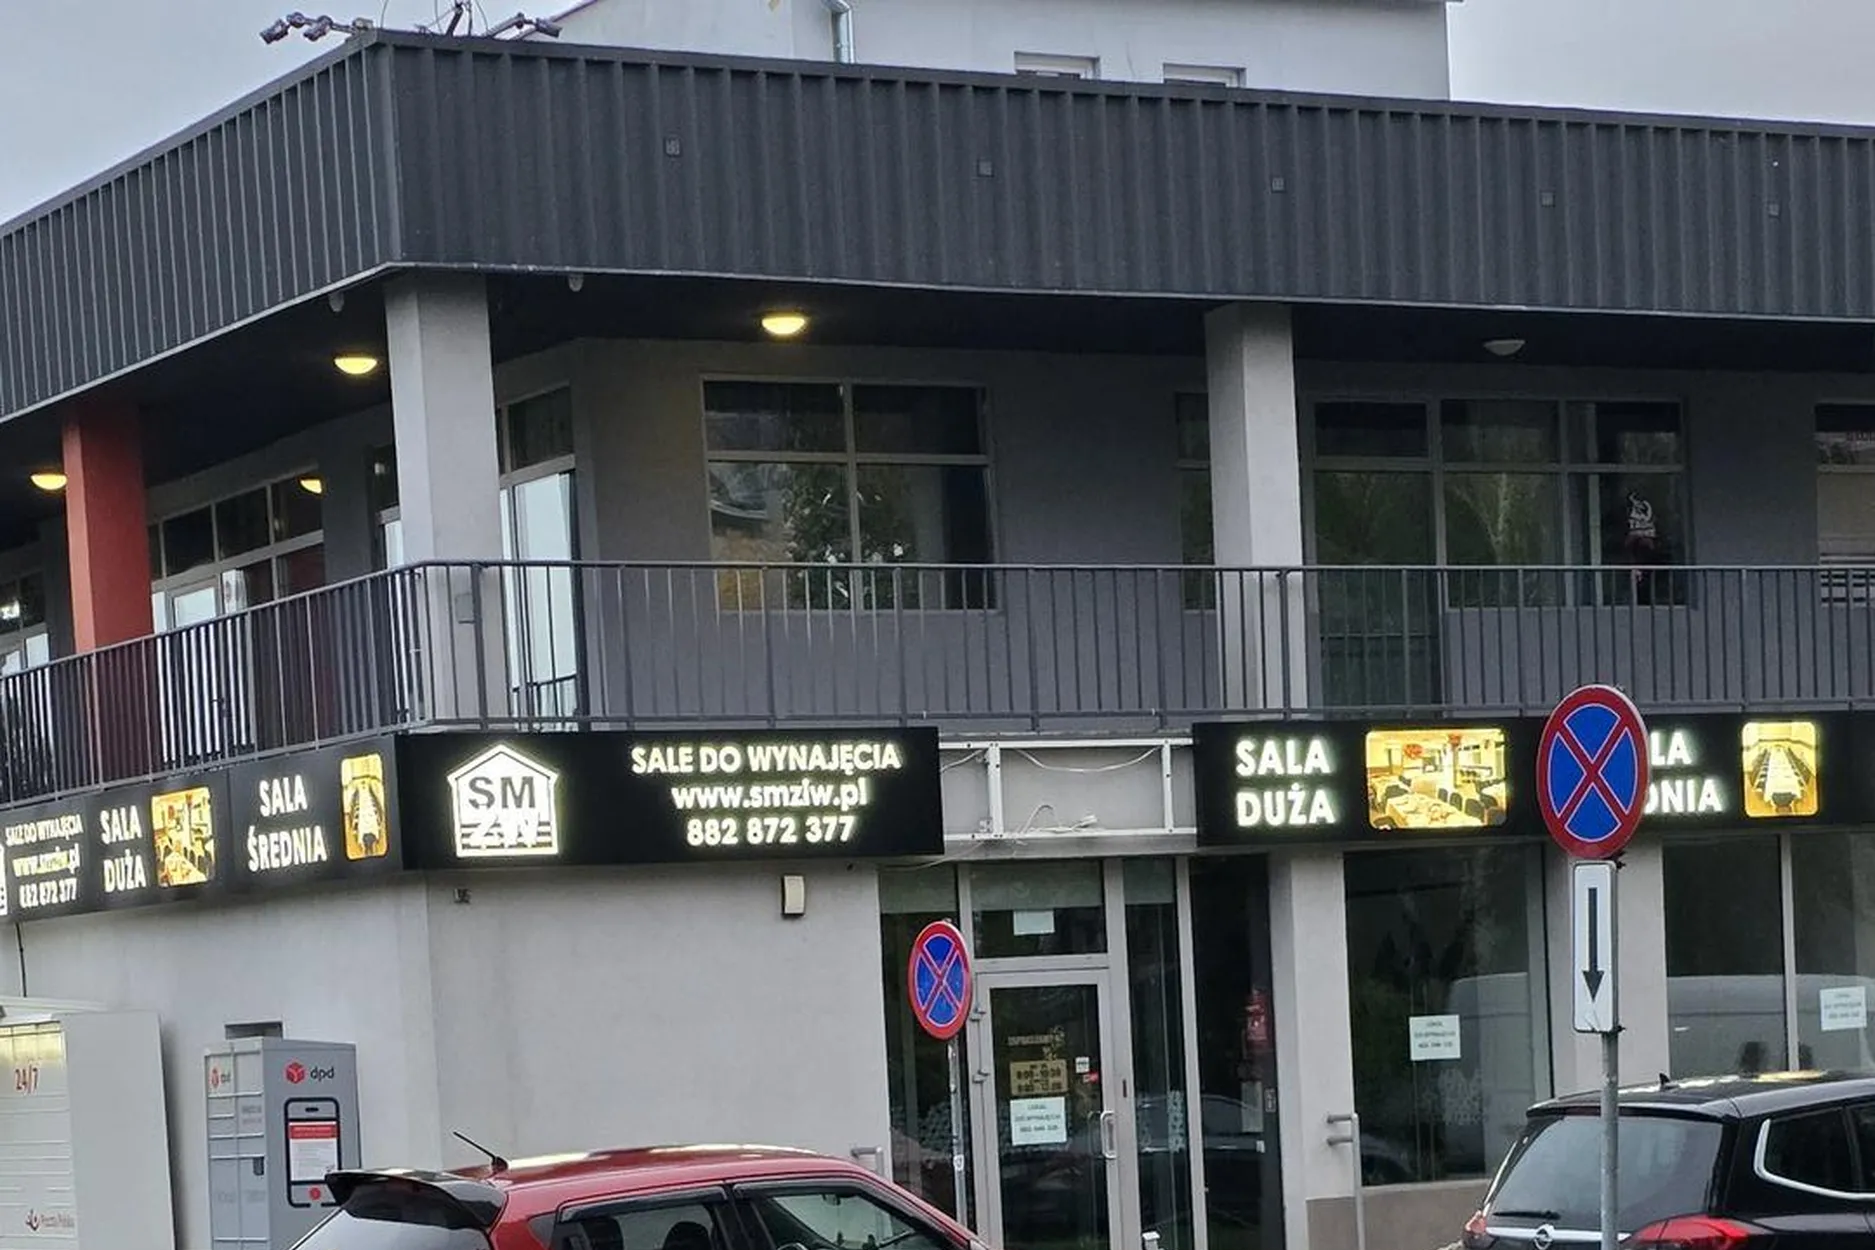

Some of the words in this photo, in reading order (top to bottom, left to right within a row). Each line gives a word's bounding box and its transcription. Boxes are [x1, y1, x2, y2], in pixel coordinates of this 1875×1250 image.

[631, 747, 693, 774] SALE
[699, 746, 741, 773] DO
[747, 743, 901, 775] WYNAJĘCIA
[1235, 739, 1332, 777] SALA
[1649, 730, 1692, 766] LA
[258, 774, 309, 818] SALA
[468, 776, 536, 810] SM
[1236, 782, 1338, 827] DUŻA
[100, 804, 143, 846] SALA
[687, 818, 739, 846] 882
[747, 816, 797, 845] 872
[805, 815, 855, 842] 377
[247, 825, 328, 873] ŚREDNIA
[103, 848, 147, 894] DUŻA
[310, 1065, 335, 1081] dpd
